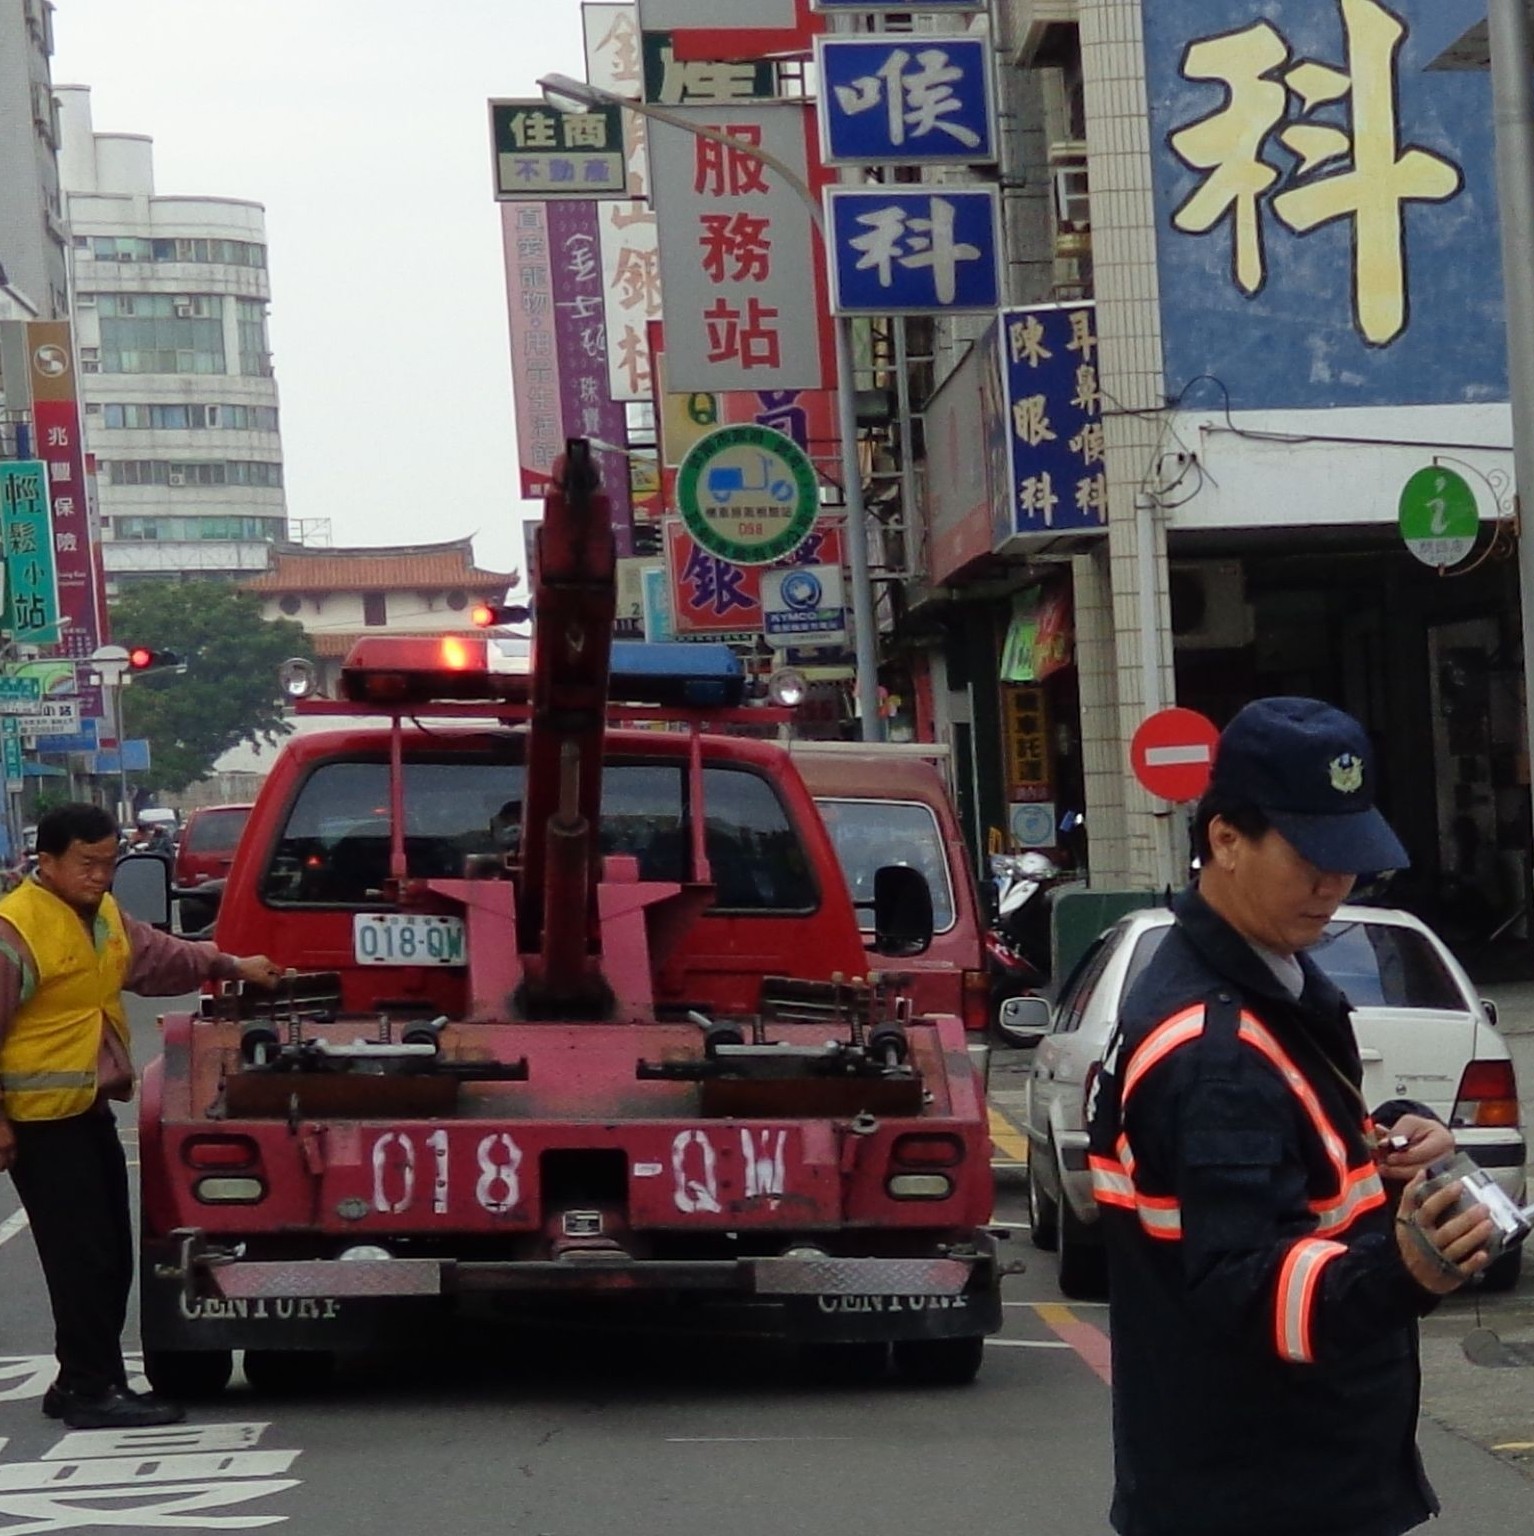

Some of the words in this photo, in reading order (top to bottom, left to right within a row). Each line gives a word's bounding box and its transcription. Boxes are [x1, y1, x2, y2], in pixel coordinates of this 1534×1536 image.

[509, 111, 606, 148] 住商
[694, 125, 781, 369] 服務站
[48, 428, 78, 551] 兆豐保險
[1009, 315, 1058, 526] 陳眼科
[5, 473, 46, 630] 輕鬆小站
[361, 926, 461, 957] 018-QW
